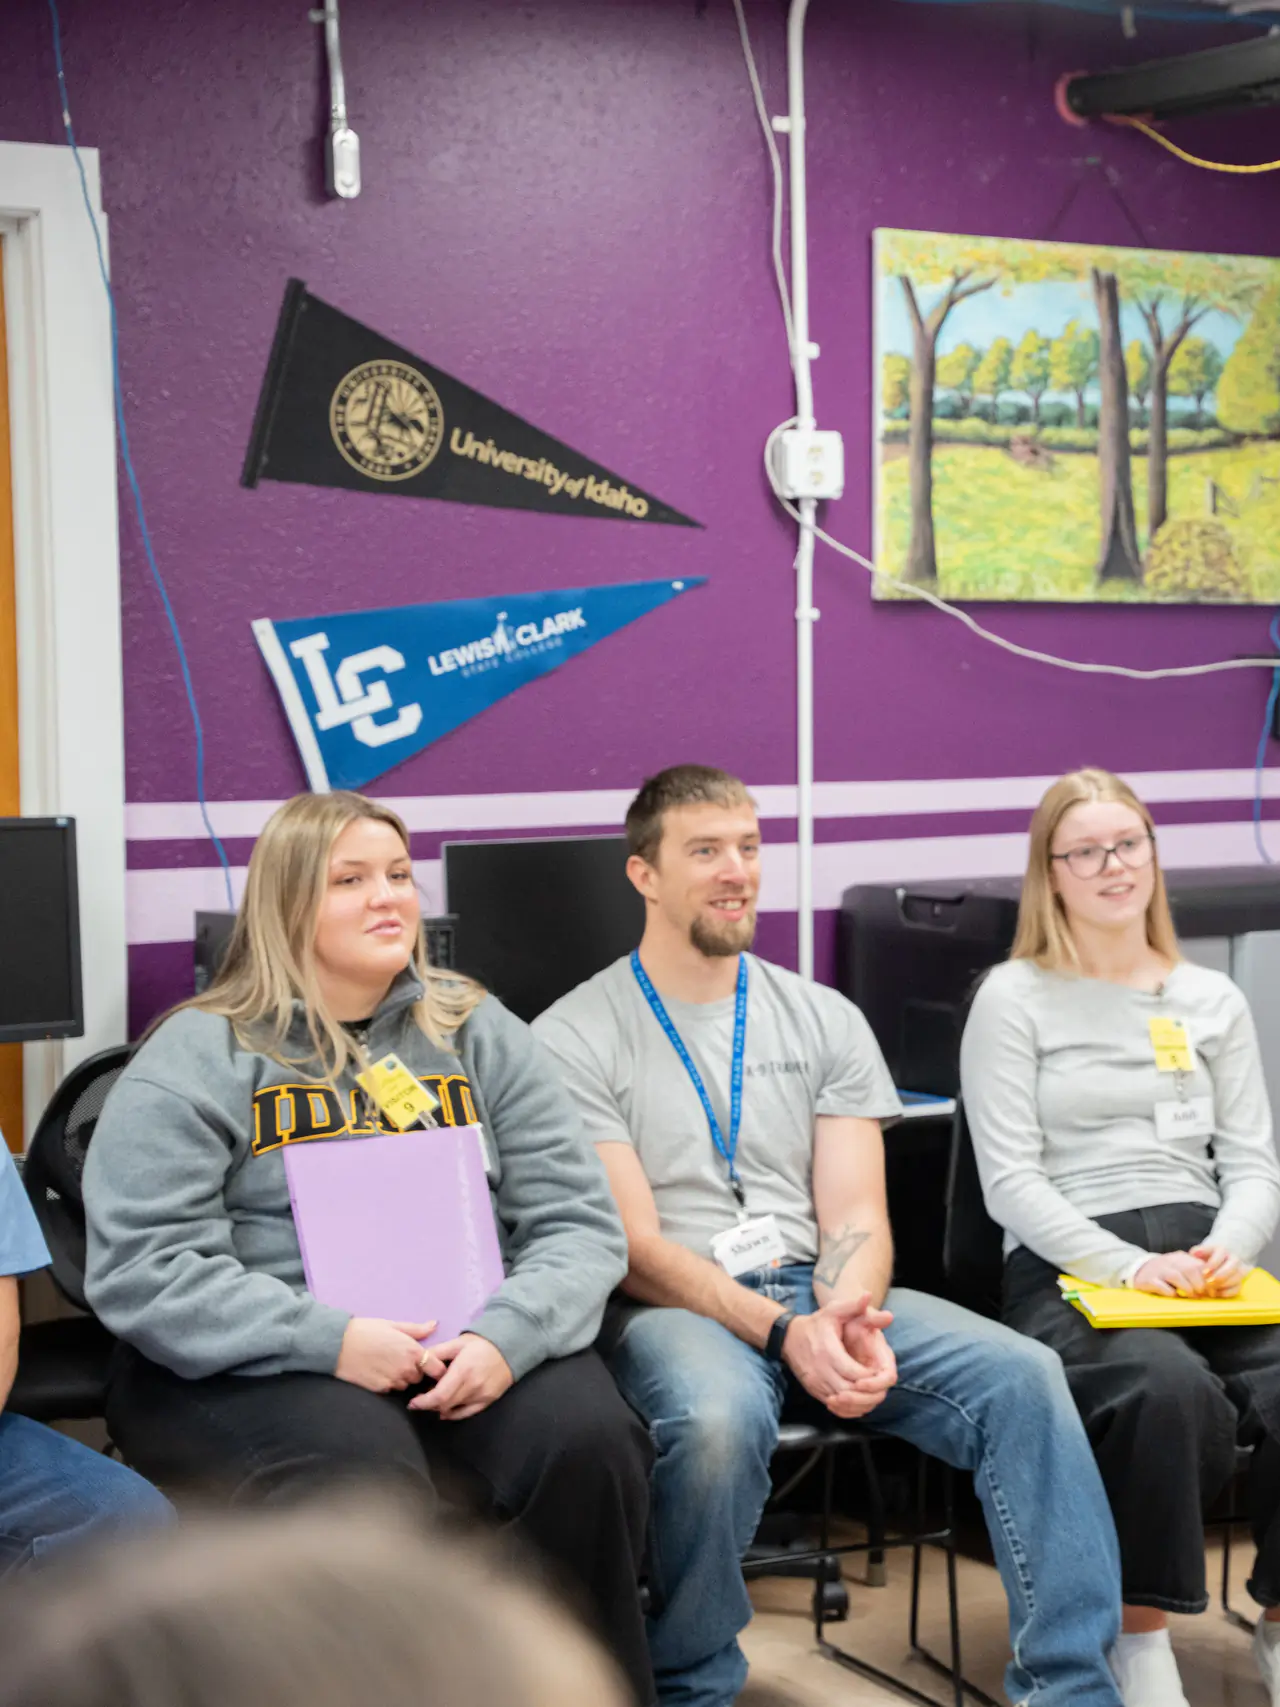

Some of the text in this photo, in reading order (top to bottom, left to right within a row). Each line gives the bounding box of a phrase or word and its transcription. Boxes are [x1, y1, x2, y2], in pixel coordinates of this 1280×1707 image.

[450, 427, 649, 518] University of Idaho
[428, 607, 587, 676] LEWIS CLARK
[289, 632, 423, 748] LC
[403, 1102, 416, 1113] 9
